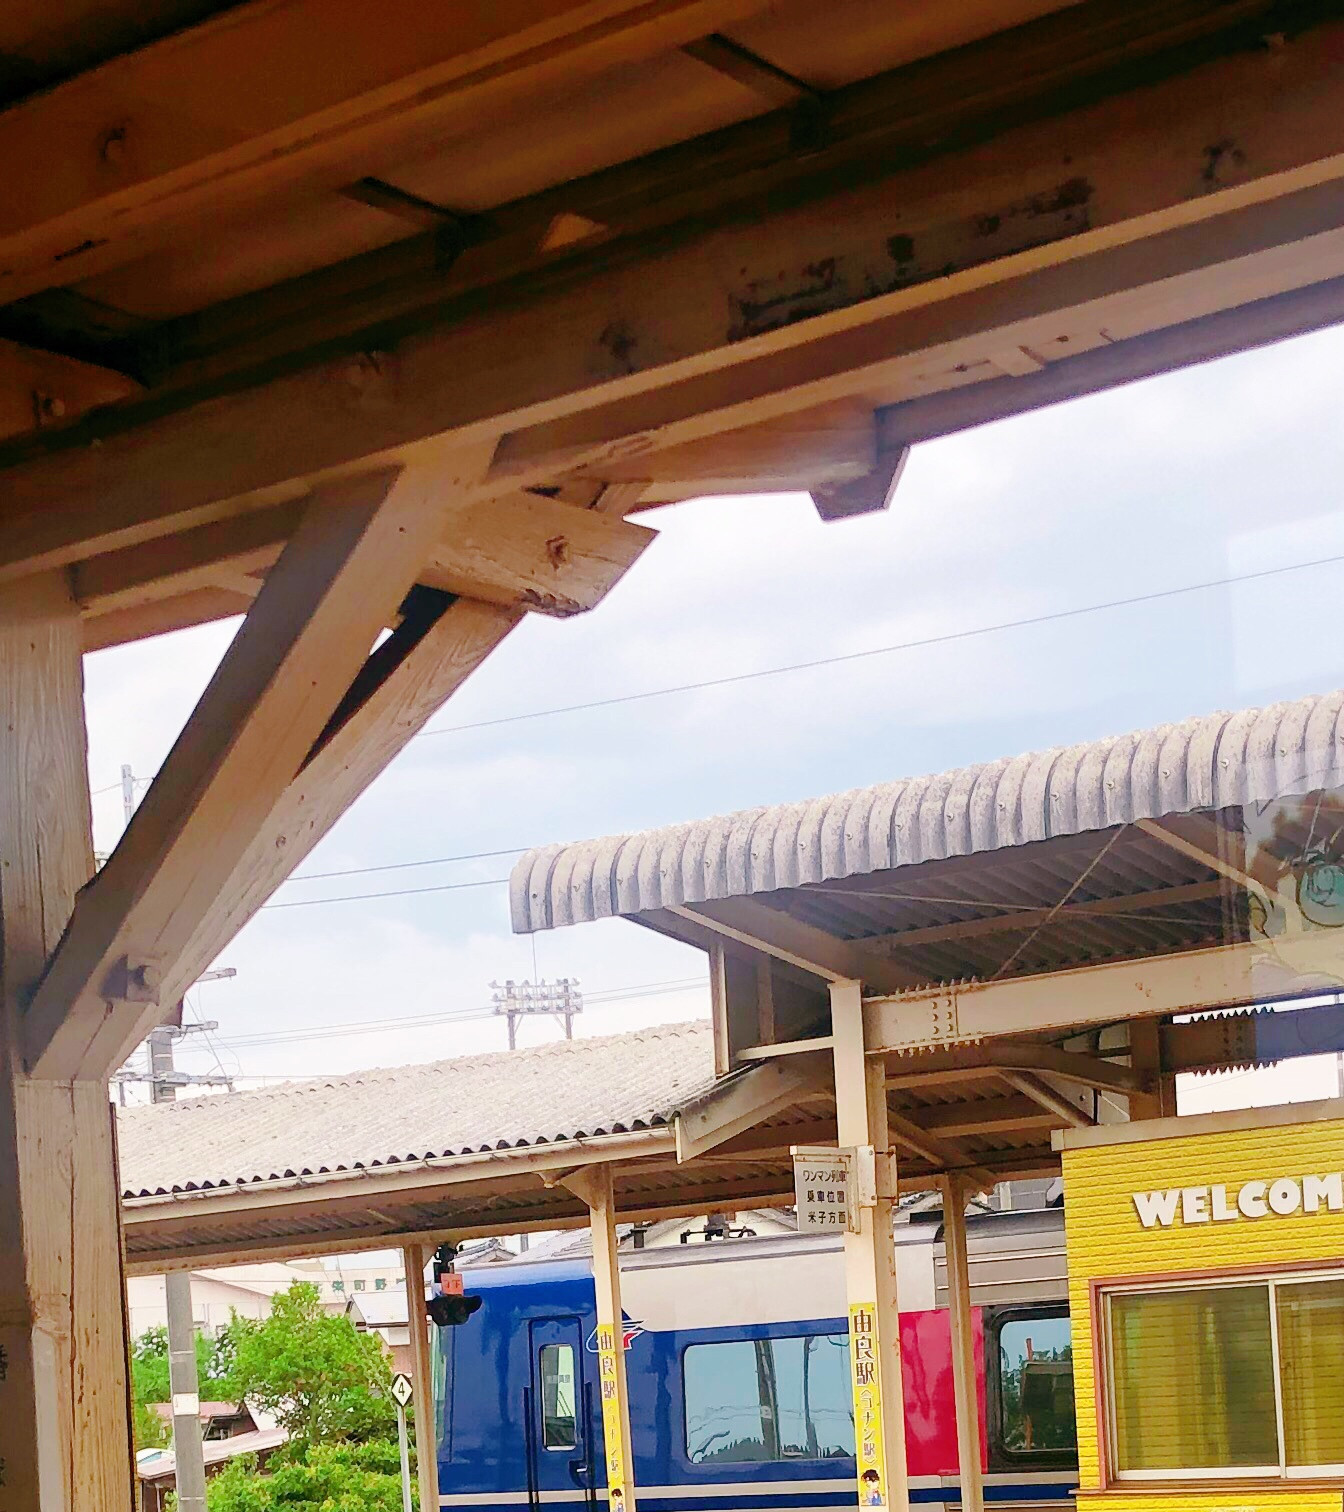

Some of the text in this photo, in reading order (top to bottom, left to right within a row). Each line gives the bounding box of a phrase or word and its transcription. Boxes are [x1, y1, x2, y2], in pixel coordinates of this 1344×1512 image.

[807, 1211, 847, 1225] 米子方面
[398, 1381, 406, 1397] 4
